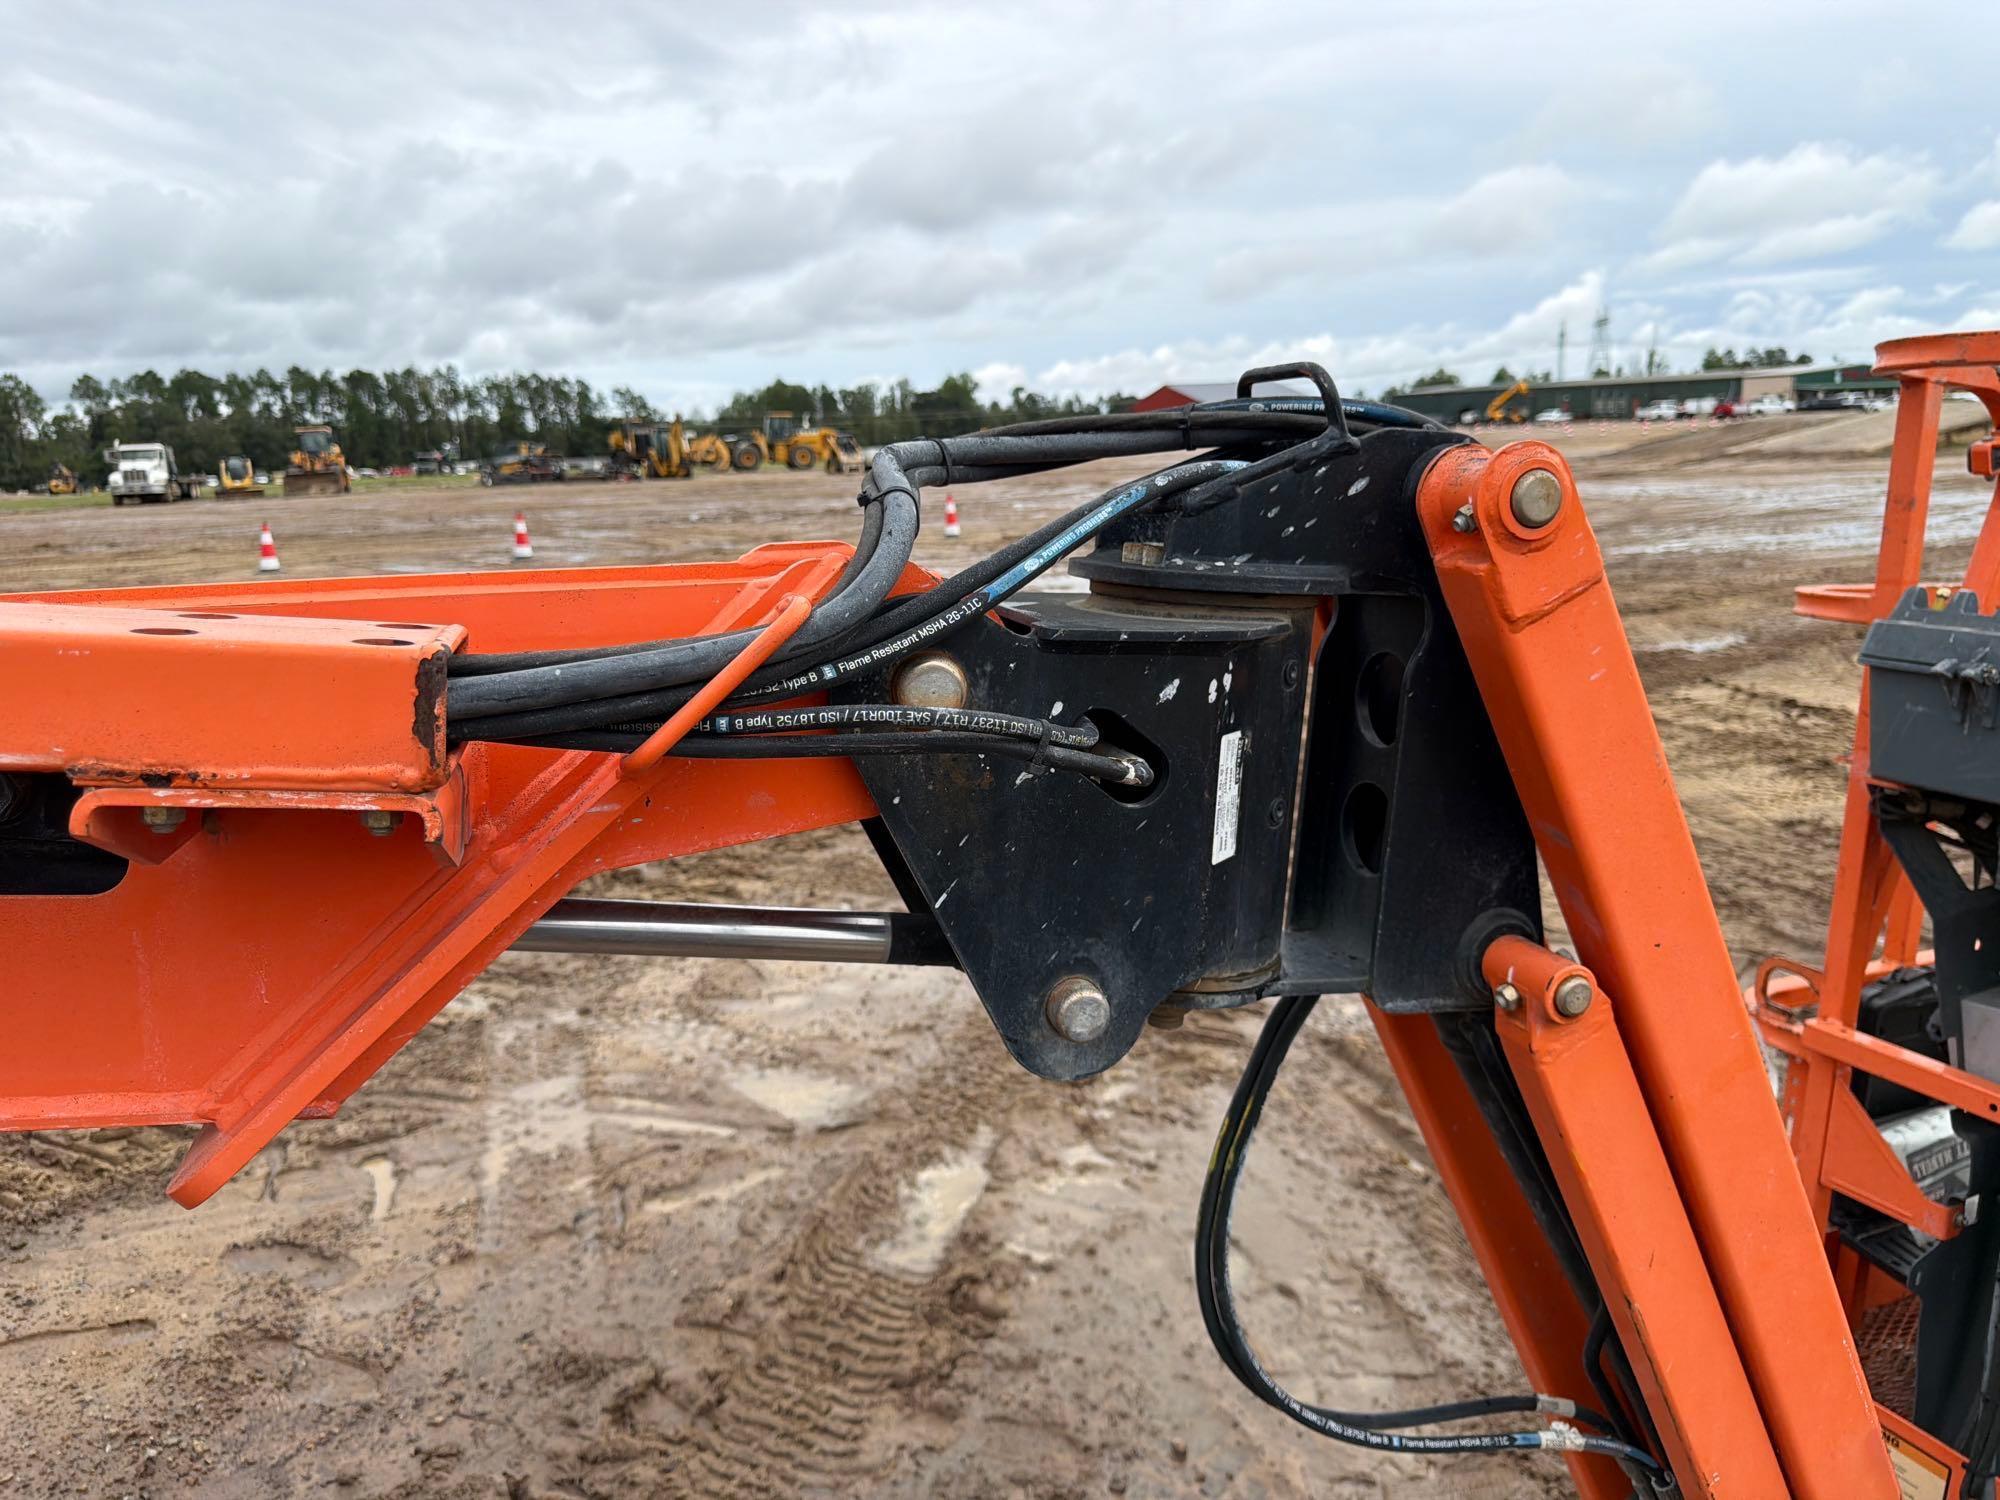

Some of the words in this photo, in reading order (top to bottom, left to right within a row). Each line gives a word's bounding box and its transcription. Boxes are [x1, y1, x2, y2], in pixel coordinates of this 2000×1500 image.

[1270, 403, 1312, 412] POWERING
[1042, 532, 1077, 559] POWERING
[782, 675, 808, 691] Type
[808, 671, 818, 682] B
[838, 654, 872, 673] Flame
[871, 634, 919, 661] Resistant
[918, 618, 948, 639] MSHA
[946, 597, 982, 624] 2G-11C
[746, 715, 772, 728] Type
[777, 712, 816, 726] 18752
[819, 711, 840, 723] ISO
[843, 709, 850, 722] /
[853, 710, 901, 722] 100R17
[906, 711, 931, 721] SAE
[943, 713, 969, 726] R17
[735, 718, 744, 730] B
[970, 717, 1008, 732] 11237
[1010, 721, 1028, 734] ISO
[1912, 1148, 1953, 1179] MANUAL
[1343, 1426, 1366, 1441] 18752
[1367, 1432, 1383, 1445] Type
[1383, 1436, 1390, 1446] B
[1402, 1438, 1424, 1448] Flame
[1425, 1438, 1460, 1448] Resistant
[1459, 1437, 1481, 1447] MSHA
